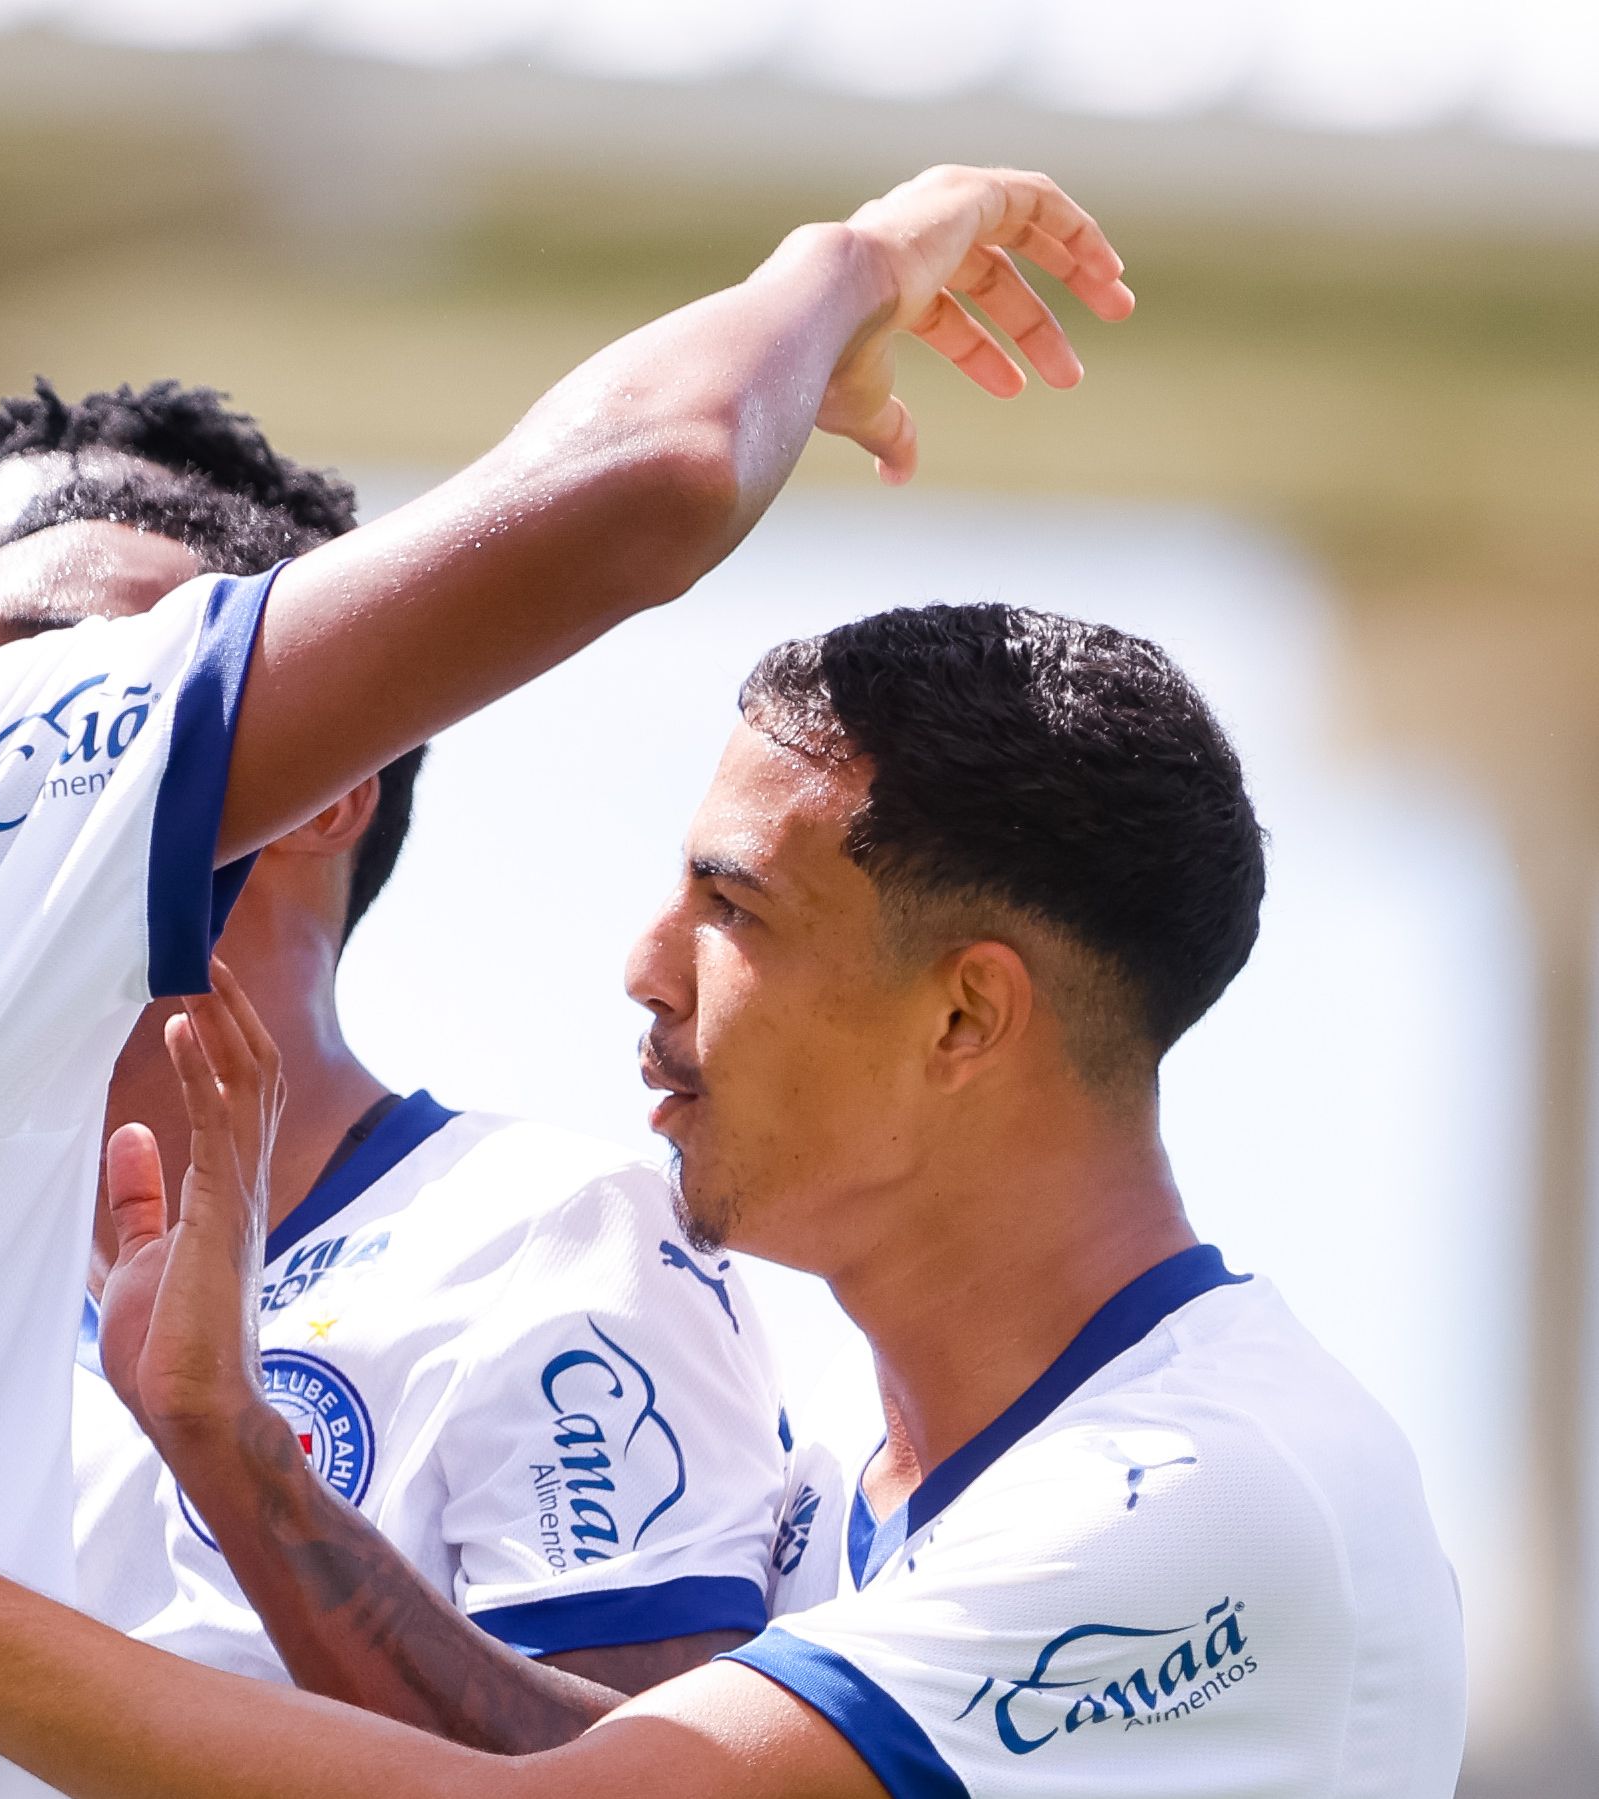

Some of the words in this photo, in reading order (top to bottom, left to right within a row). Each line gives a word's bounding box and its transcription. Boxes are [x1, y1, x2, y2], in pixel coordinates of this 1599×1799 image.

[328, 1416, 355, 1489] BAHI
[995, 1596, 1248, 1755] Canaã
[1125, 1655, 1258, 1732] Alimentos
